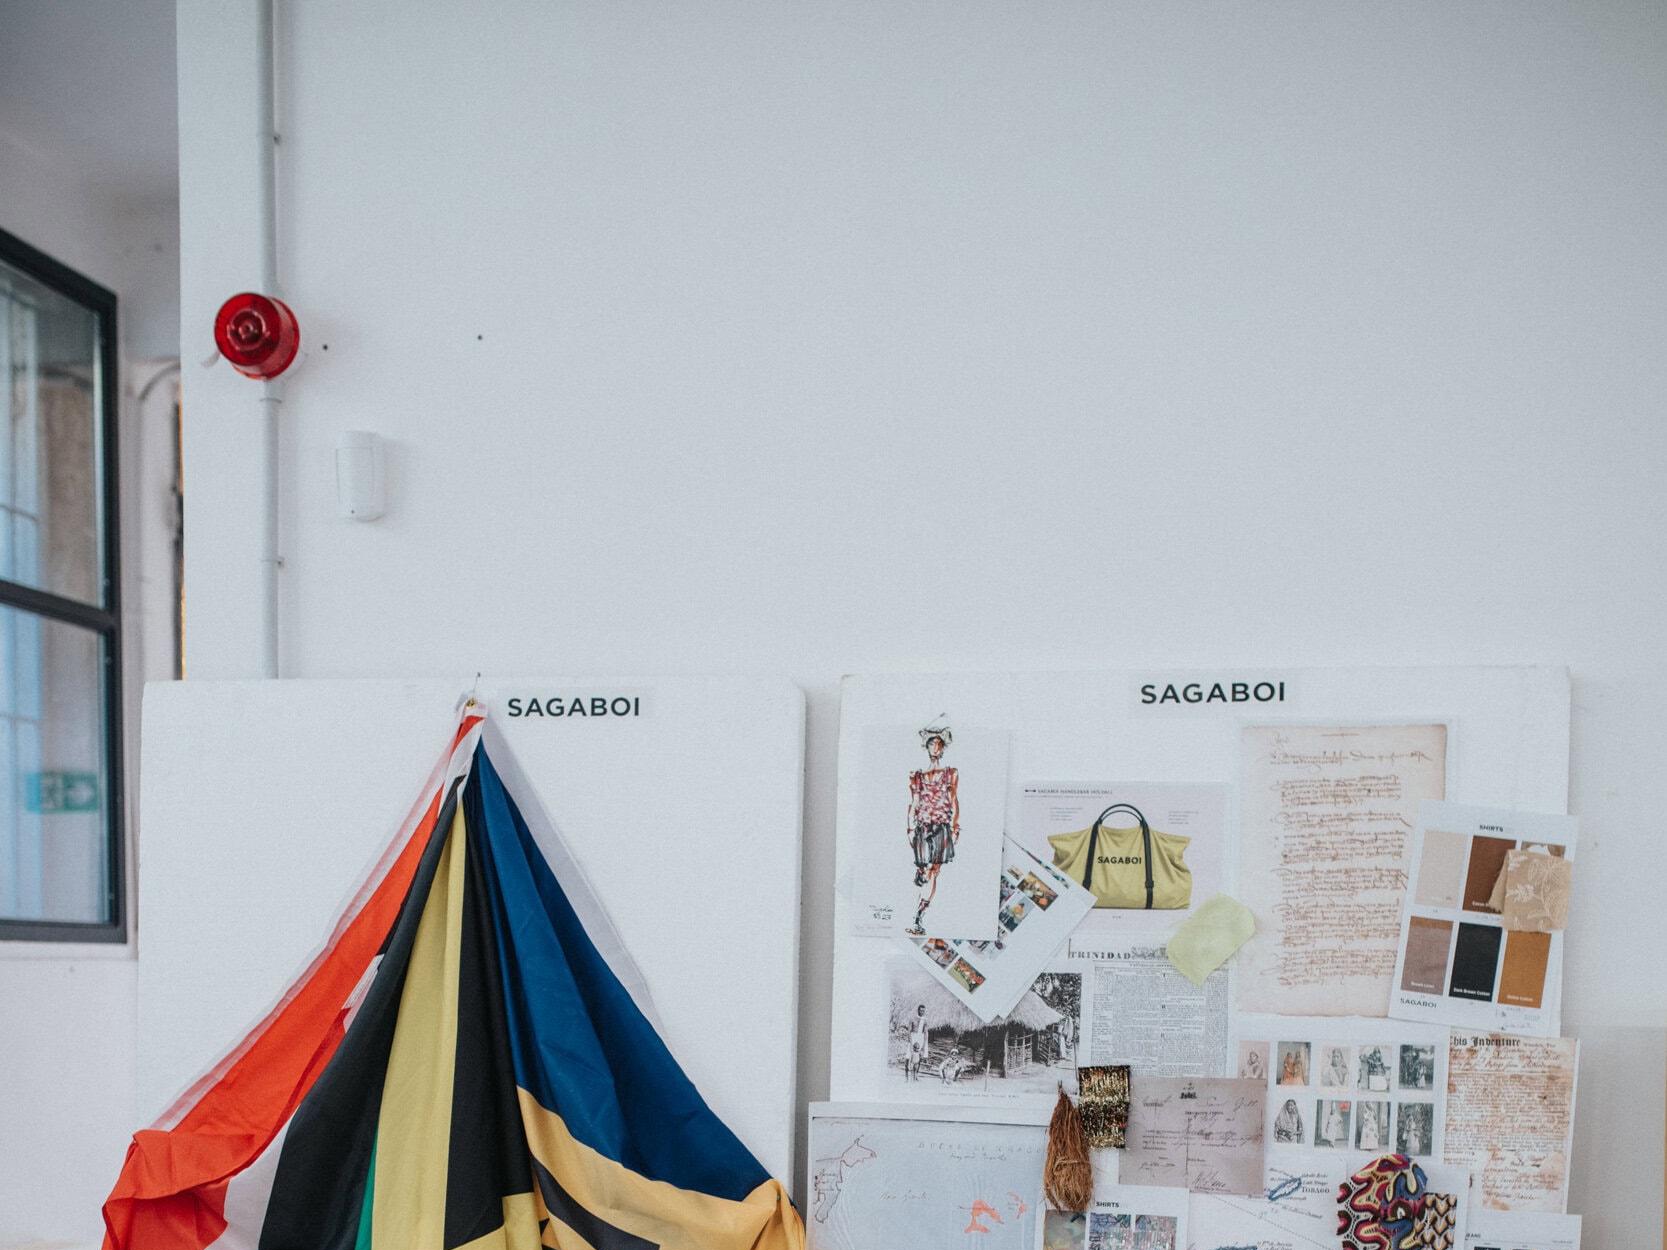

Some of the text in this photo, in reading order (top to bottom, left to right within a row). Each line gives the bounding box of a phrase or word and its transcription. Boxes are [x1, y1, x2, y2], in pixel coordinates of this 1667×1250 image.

[1140, 681, 1285, 704] SAGABOI
[507, 697, 640, 717] SAGABOI
[1479, 824, 1504, 832] SHIRTS
[1097, 855, 1142, 865] SAGABOI
[1070, 951, 1131, 960] TRINIDAD
[1400, 998, 1437, 1008] SAGABOI
[1470, 1035, 1521, 1047] Indenture
[1301, 1186, 1330, 1194] TOBAGO
